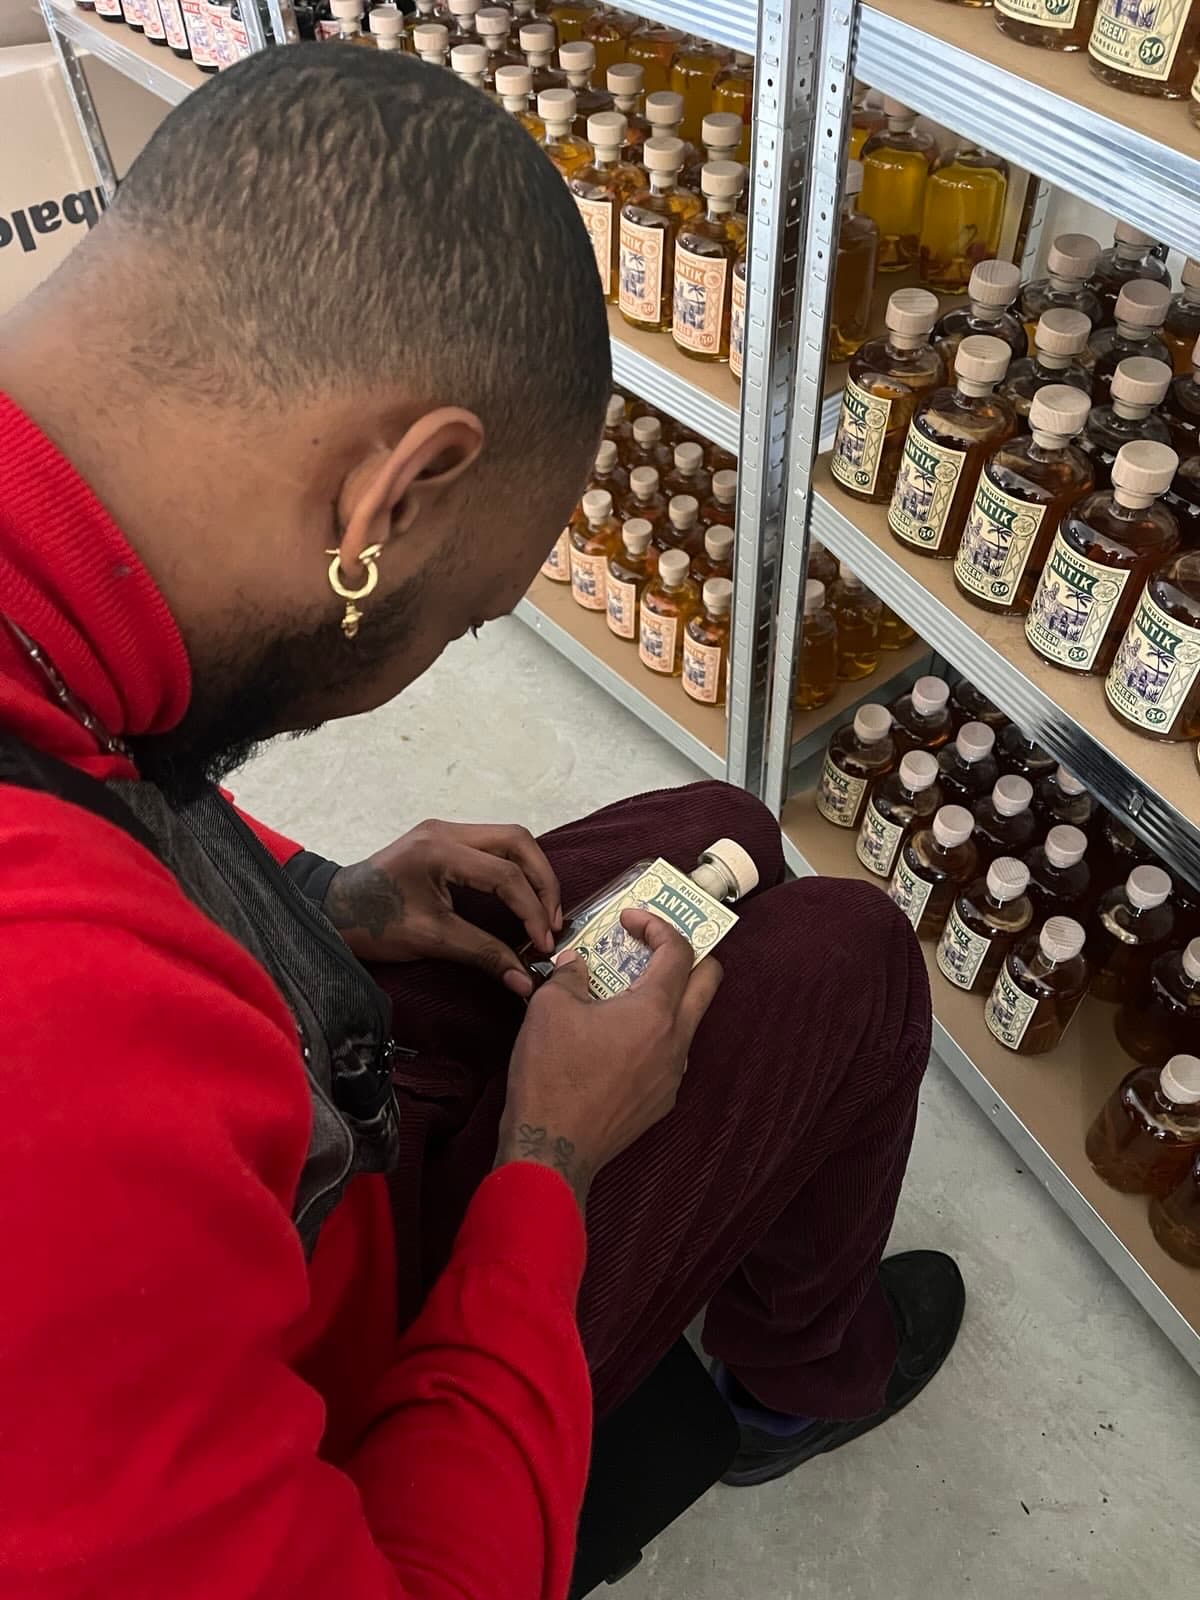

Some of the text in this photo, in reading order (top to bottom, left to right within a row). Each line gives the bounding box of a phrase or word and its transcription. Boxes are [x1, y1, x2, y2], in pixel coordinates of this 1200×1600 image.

[1100, 17, 1127, 43] GREEN
[1140, 38, 1164, 59] 50
[977, 490, 1013, 526] ANTIK
[919, 528, 935, 539] 50
[1062, 550, 1086, 570] RHUM
[1052, 553, 1093, 591] ANTIK
[991, 583, 1009, 594] 50
[1147, 606, 1169, 628] RHUM
[1035, 624, 1059, 646] GREEN
[1137, 611, 1176, 651] ANTIK
[1069, 647, 1088, 658] 50
[1114, 681, 1136, 705] GREEN
[1146, 709, 1166, 720] 50
[679, 884, 704, 906] RHUM
[655, 891, 701, 931] ANTIK
[588, 976, 609, 999] RSEIL
[594, 964, 624, 993] GREEN
